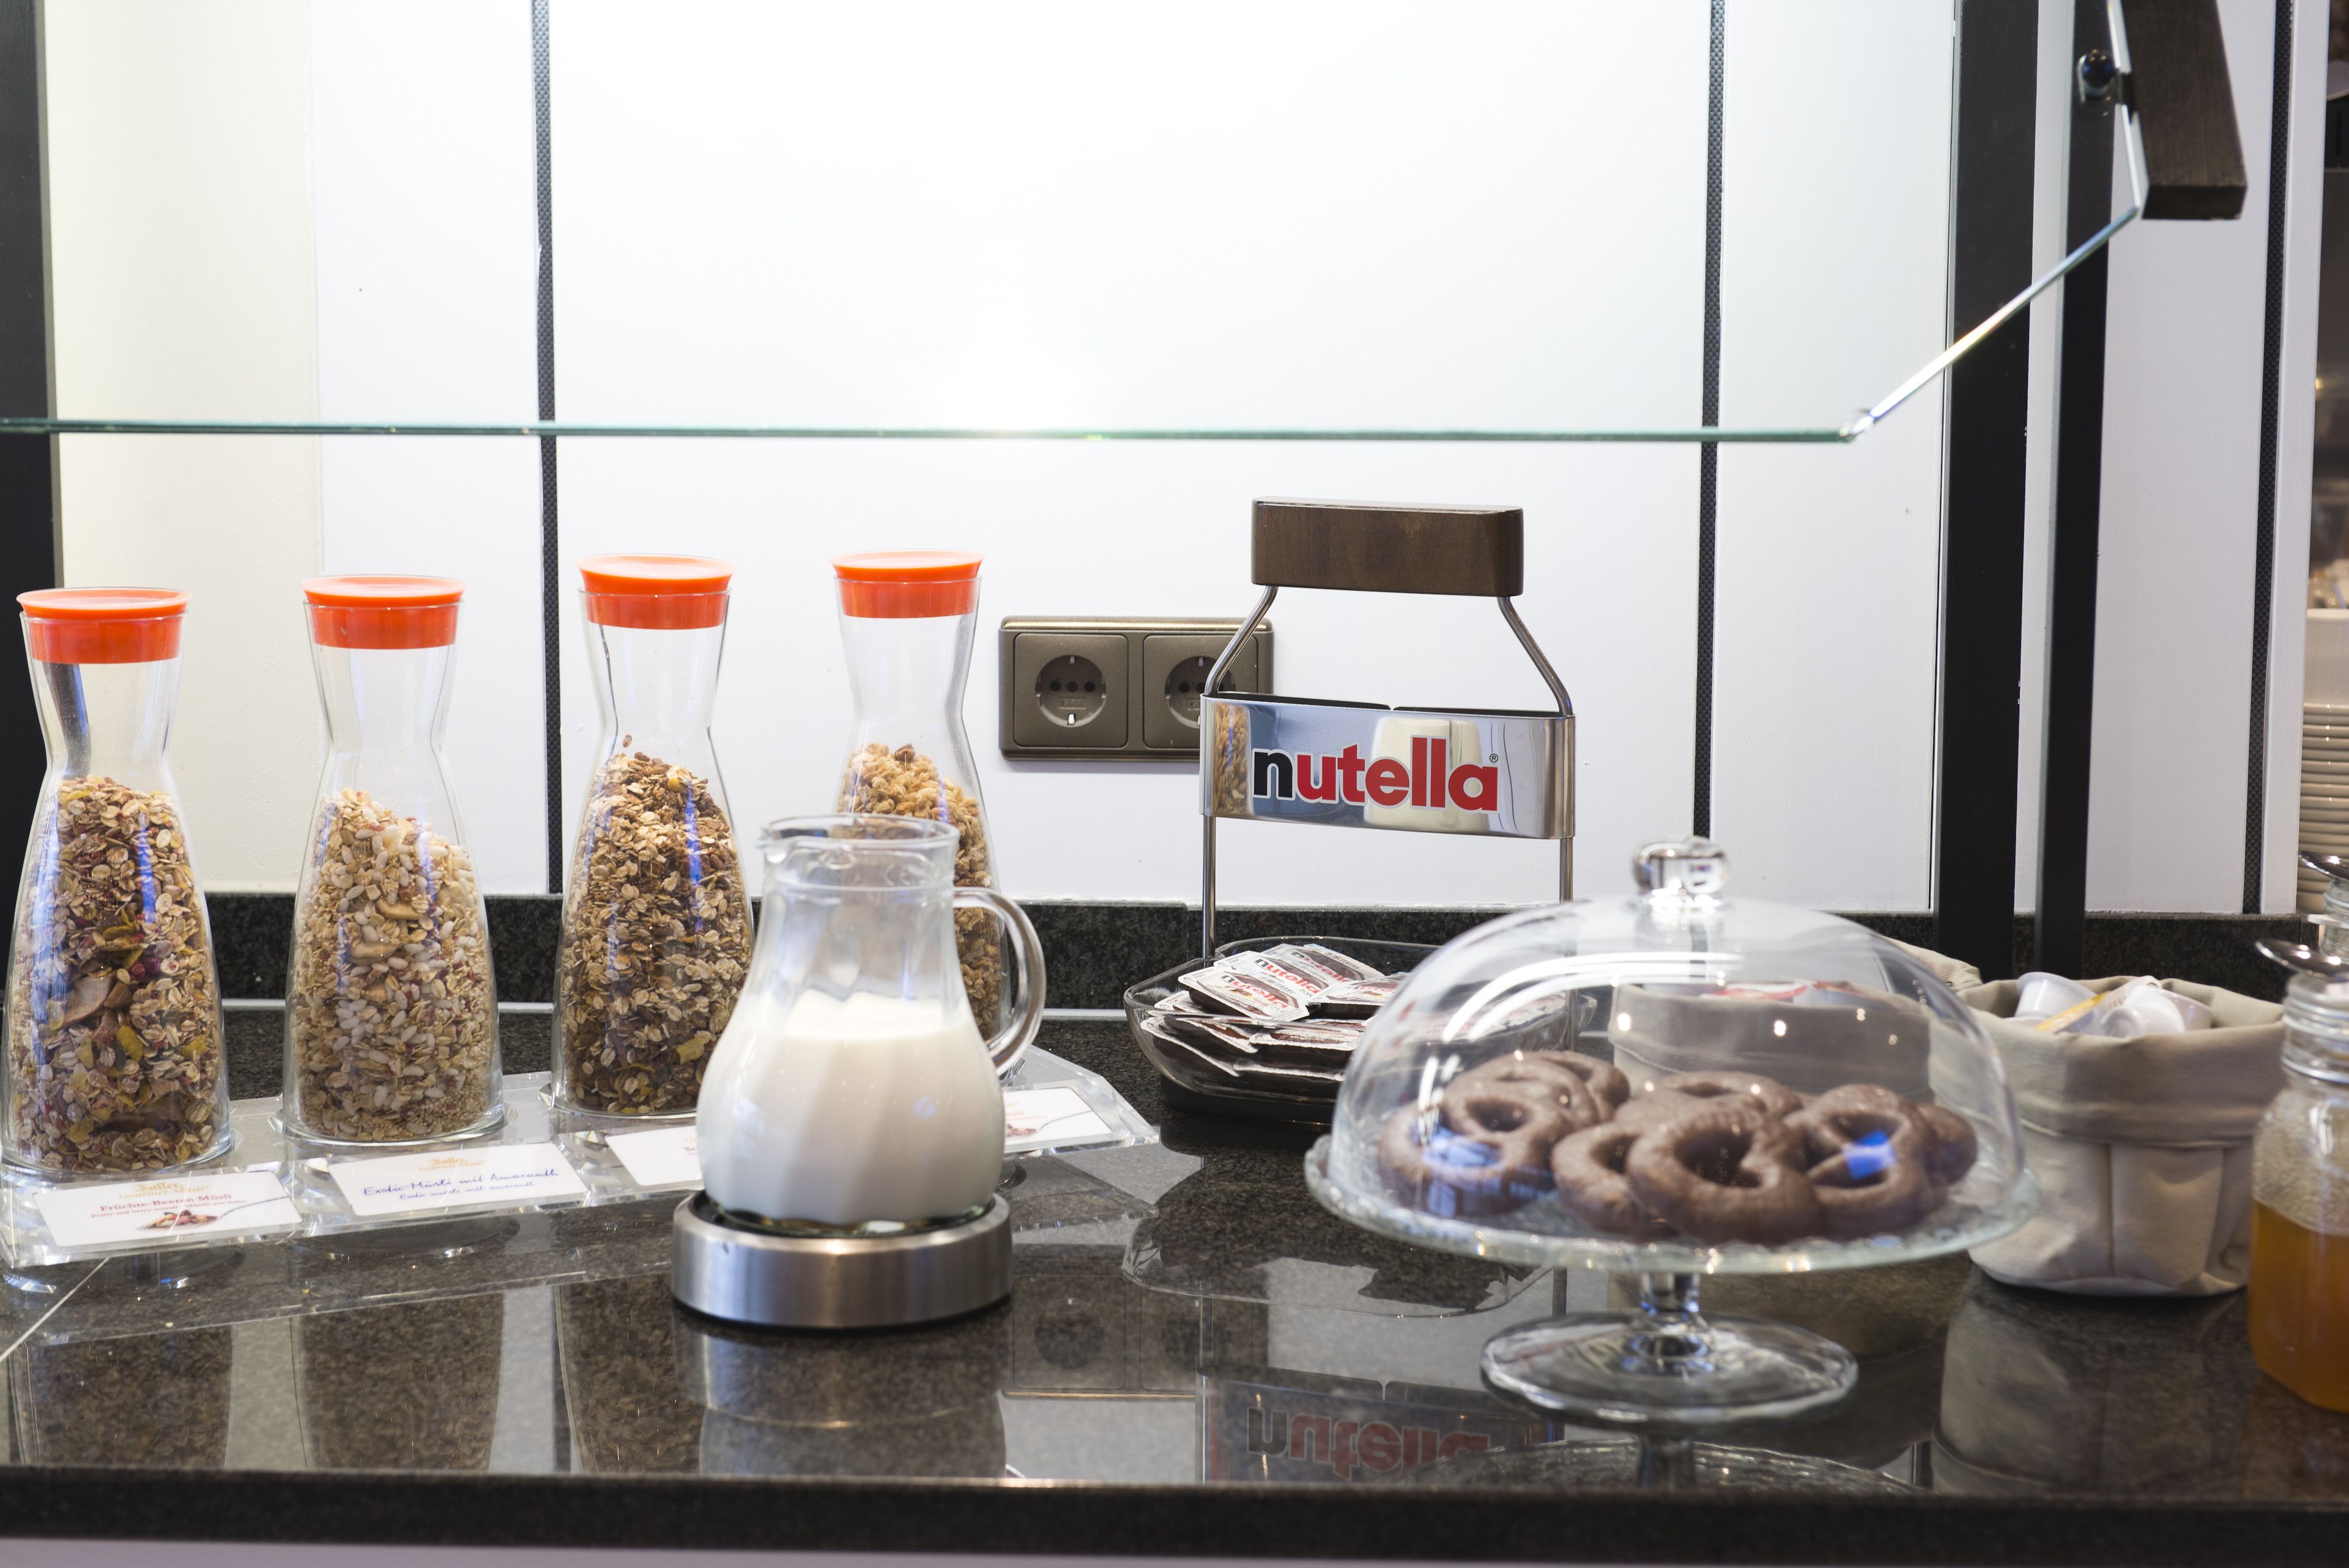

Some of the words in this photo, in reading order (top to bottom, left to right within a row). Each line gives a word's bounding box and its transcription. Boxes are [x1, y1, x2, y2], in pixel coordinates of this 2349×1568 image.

[1254, 737, 1498, 811] nutella
[1222, 975, 1288, 1008] nutella
[1255, 959, 1320, 994] nutella
[459, 1175, 483, 1184] mit
[198, 1193, 232, 1203] Müsli
